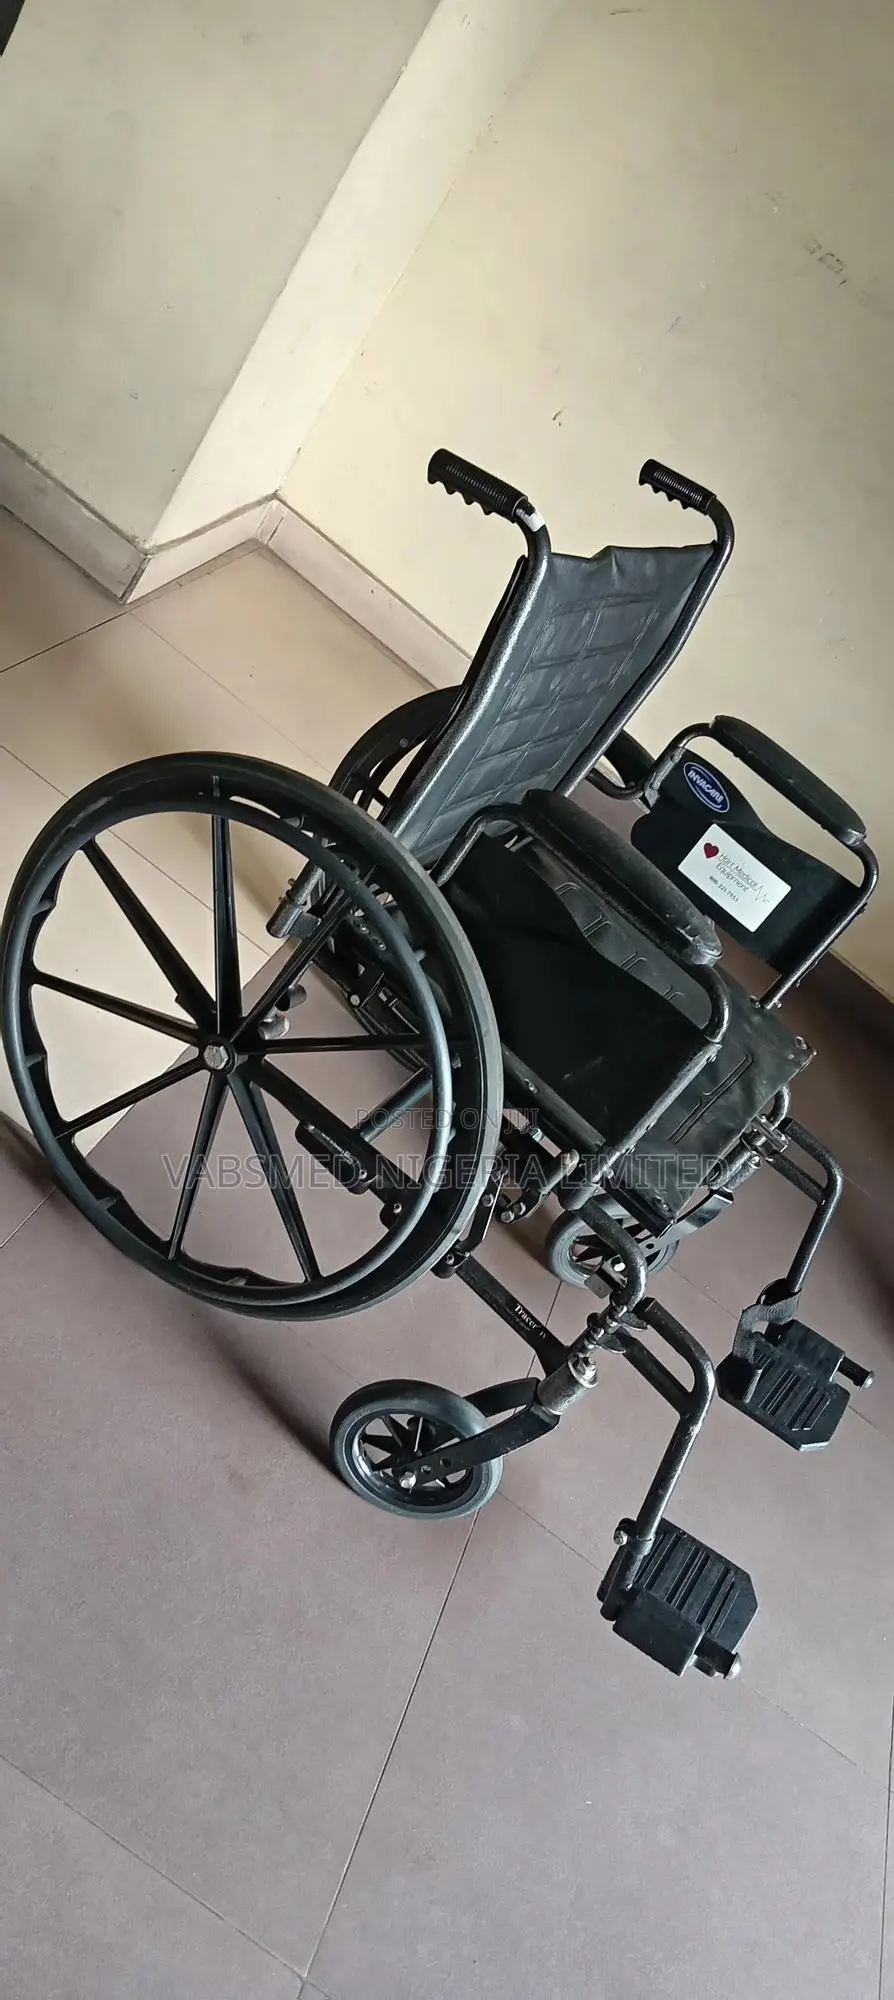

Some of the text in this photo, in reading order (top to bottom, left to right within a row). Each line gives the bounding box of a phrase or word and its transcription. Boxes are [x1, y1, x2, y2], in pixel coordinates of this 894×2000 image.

[687, 769, 724, 804] INVACARE
[715, 862, 749, 893] Equipment
[733, 864, 759, 888] Medical
[514, 1303, 538, 1329] Tracer
